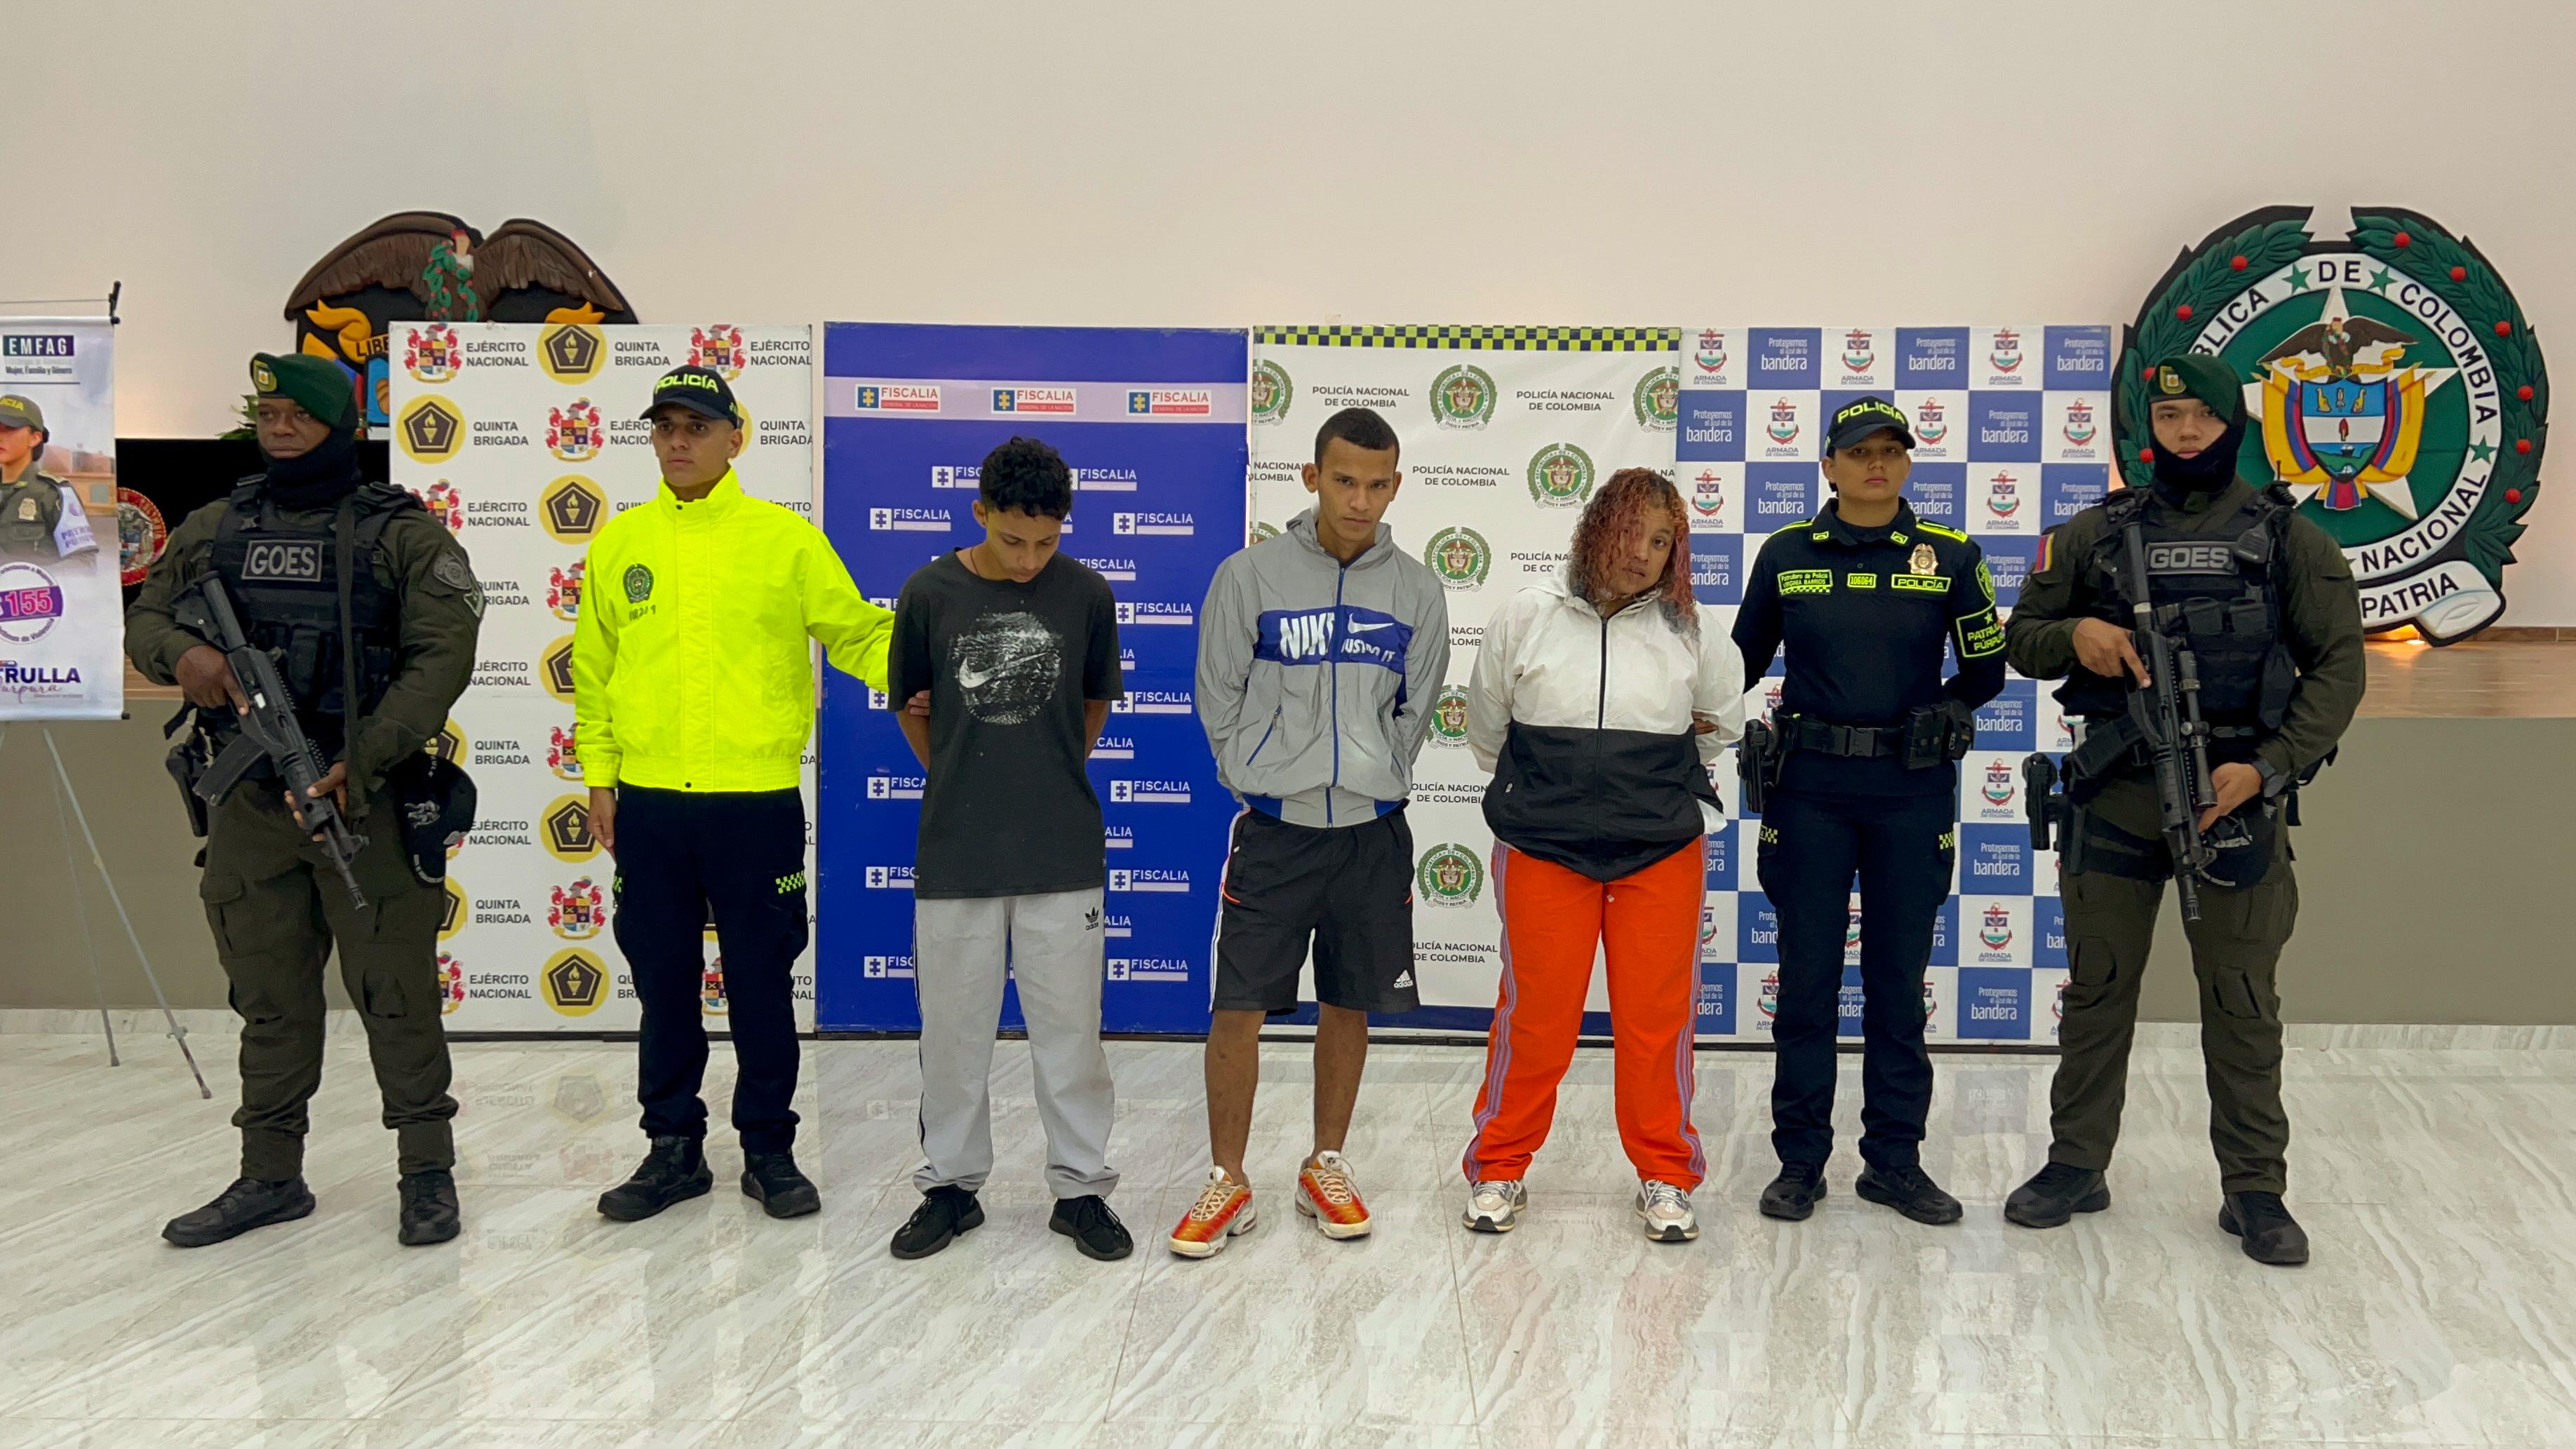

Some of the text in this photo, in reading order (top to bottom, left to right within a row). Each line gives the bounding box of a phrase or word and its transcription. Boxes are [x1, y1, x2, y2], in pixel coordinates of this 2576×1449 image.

[9, 337, 67, 355] EMFAG
[466, 341, 525, 352] EJÉRCITO
[615, 342, 659, 352] QUINTA
[751, 339, 810, 351] EJÉRCITO
[1769, 337, 1807, 348] Protegemos
[2319, 260, 2361, 282] DE
[2399, 283, 2497, 424] COLOMBIA
[467, 357, 528, 366] NACIONAL
[615, 356, 671, 365] BRIGADA
[751, 356, 812, 365] NACIONAL
[1762, 353, 1807, 370] bandera
[1909, 354, 1955, 370] bandera
[2057, 355, 2104, 371] bandera
[654, 374, 719, 393] POLICÍA
[881, 387, 938, 398] FISCALIA
[1017, 390, 1073, 400] FISCALIA
[1313, 385, 1409, 396] POLICÍA NACIONAL
[1517, 389, 1614, 400] POLICÍA NACIONAL
[1152, 392, 1208, 403] FISCALIA
[1341, 398, 1396, 407] COLOMBIA
[1546, 403, 1601, 411] COLOMBIA
[1693, 410, 1732, 420] Protegemos
[1837, 401, 1906, 425] POLICÍA
[474, 422, 518, 431] QUINTA
[610, 419, 653, 431] EJÉRC
[760, 421, 805, 431] QUINTA
[1686, 426, 1732, 442] bandera
[1982, 427, 2028, 443] bandera
[474, 436, 528, 445] BRIGADA
[610, 436, 652, 445] NACIO
[760, 435, 812, 445] BRIGADA
[955, 466, 983, 477] FISC
[1080, 469, 1136, 479] FISCALIA
[1412, 465, 1510, 476] POLICÍA NACIONAL
[1766, 482, 1804, 492] Protegemos
[1913, 482, 1952, 492] Protegemos
[468, 501, 527, 512] EJÉRCITO
[1759, 498, 1804, 514] bandera
[894, 508, 951, 520] FISCALIA
[1137, 513, 1193, 524] FISCALIA
[468, 517, 530, 526] NACIONAL
[2361, 472, 2487, 574] NACIONAL
[250, 545, 315, 576] GOES
[1511, 551, 1551, 561] POLICÍA
[1690, 553, 1729, 563] Protegemos
[2150, 547, 2229, 568] GOES
[1690, 570, 1729, 585] andera
[1898, 579, 1944, 589] POLICÍA
[485, 596, 530, 605] RIGADA
[2362, 573, 2459, 619] PATRIA
[6, 588, 53, 616] 155
[1136, 603, 1192, 613] FISCALIA
[1967, 623, 2001, 641] PATRU
[469, 676, 531, 686] NACIONAL
[1135, 692, 1191, 702] FISCALIA
[1976, 715, 2022, 732] bandera
[475, 741, 520, 751] QUINTA
[1095, 737, 1134, 748] CALIA
[475, 755, 530, 764] BRIGADA
[892, 777, 926, 788] FISCA
[1134, 781, 1190, 791] FISCALIA
[1411, 782, 1487, 793] OLICÍA NACION
[1433, 795, 1480, 804] COLOMBI
[470, 819, 529, 830] EJÉRCITO
[1105, 826, 1133, 837] ALIA
[469, 835, 531, 845] NACIONAL
[1981, 843, 2020, 853] Protegemos
[890, 867, 915, 877] FISC
[1974, 859, 2020, 876] bandera
[1133, 870, 1189, 881] FISCALIA
[476, 900, 521, 910] QUINTA
[476, 914, 531, 924] BRIGADA
[1444, 943, 1498, 952] NACIONAL
[1430, 954, 1485, 963] COLOMBIA
[1132, 959, 1188, 970] FISCALIA
[470, 973, 529, 984] EJÉRCITO
[470, 989, 532, 999] NACIONAL
[1978, 987, 2018, 997] Protegemos
[1971, 1004, 2017, 1020] bandera
